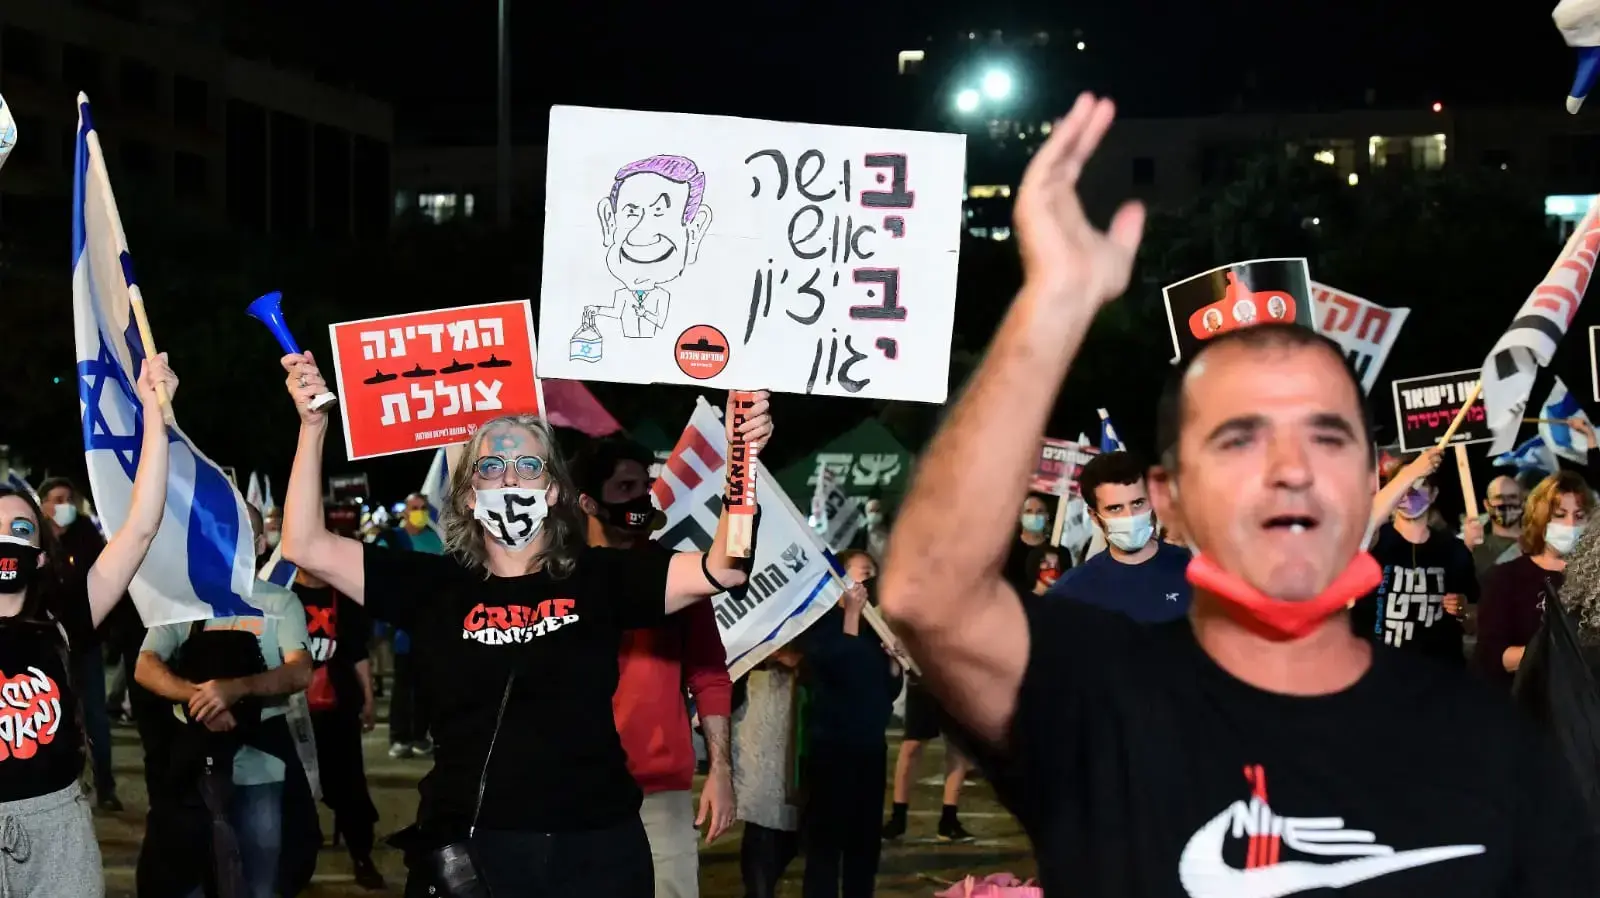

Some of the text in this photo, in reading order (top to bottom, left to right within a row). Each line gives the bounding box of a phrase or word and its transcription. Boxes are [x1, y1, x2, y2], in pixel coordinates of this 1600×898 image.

[745, 149, 915, 208] בושה
[360, 317, 505, 361] המדינה
[806, 328, 898, 394] יגון
[380, 379, 504, 426] צוללת
[1407, 405, 1488, 431] מורטיה
[486, 494, 536, 546] 15
[1393, 565, 1445, 593] דמו
[462, 613, 580, 646] MINISTER
[463, 598, 576, 632] CRIME
